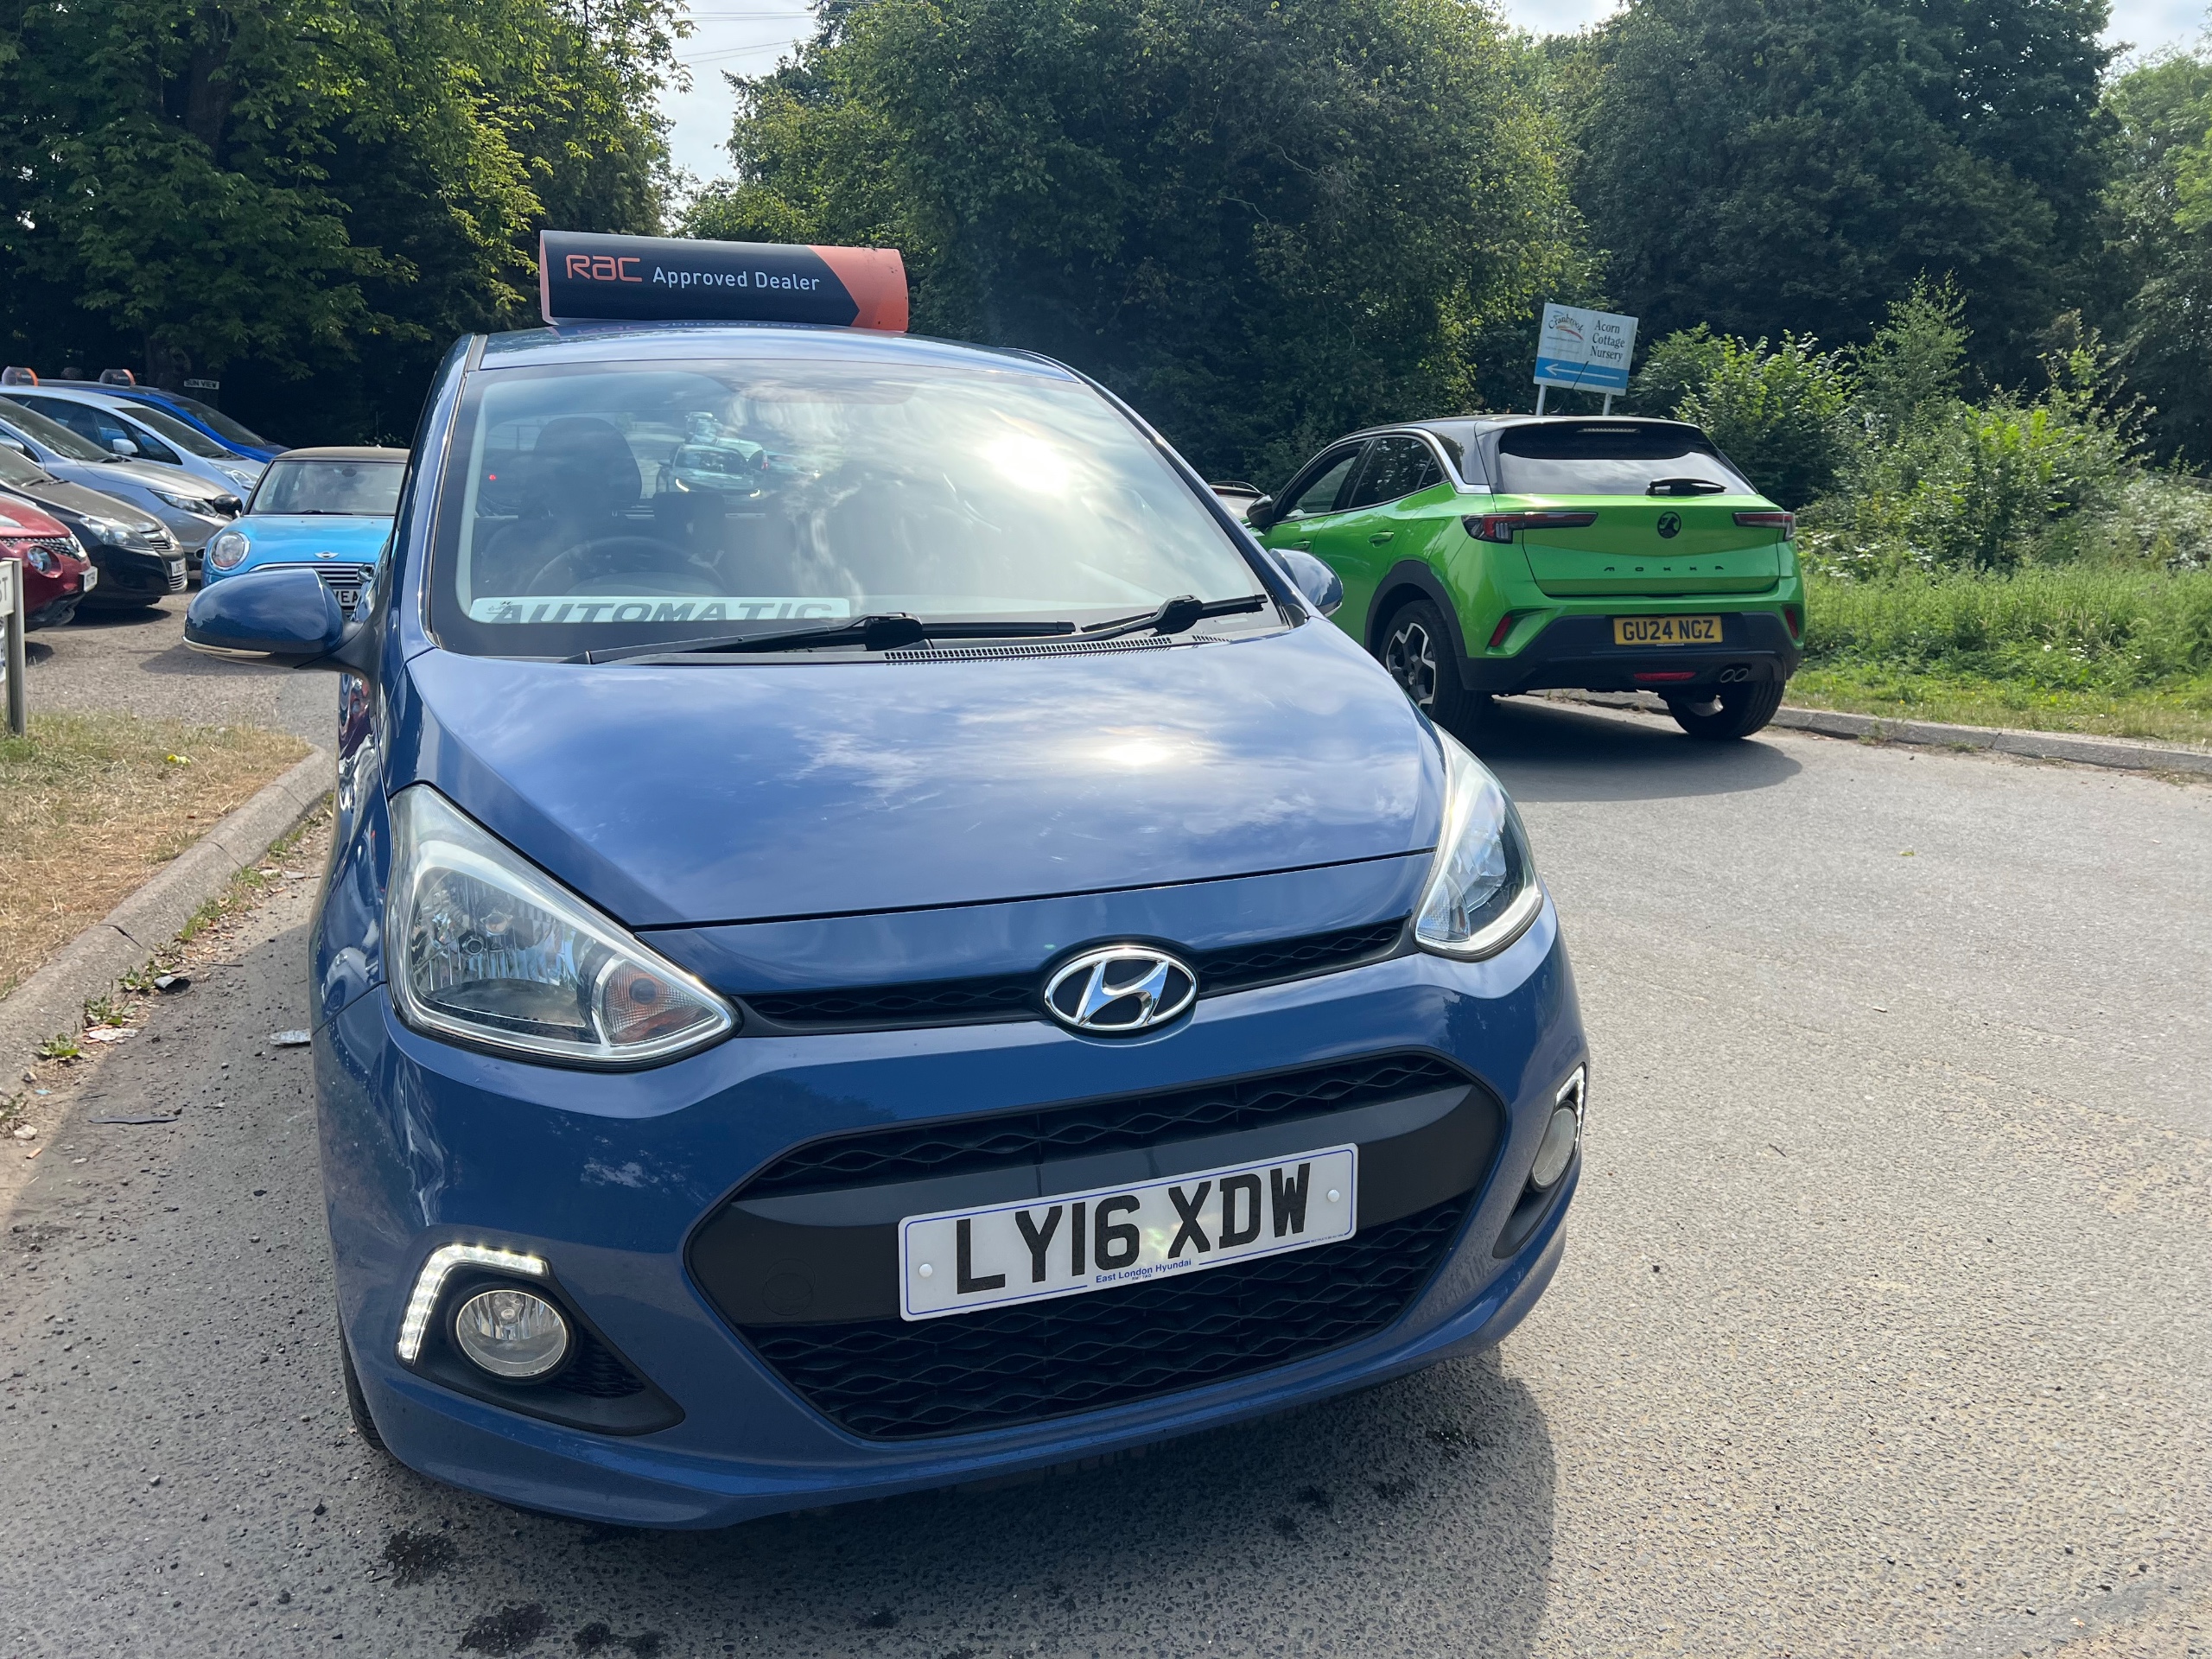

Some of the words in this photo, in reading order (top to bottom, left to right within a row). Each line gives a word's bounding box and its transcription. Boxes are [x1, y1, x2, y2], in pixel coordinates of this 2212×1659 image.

[652, 267, 747, 289] Approved
[756, 272, 820, 291] Dealer
[1548, 314, 1584, 333] Cranbrook
[1594, 320, 1620, 334] Acorn
[1592, 333, 1624, 349] Cottage
[1590, 346, 1623, 362] Nursery
[490, 602, 834, 623] AUTOMATIC
[1623, 620, 1673, 641] GU24
[1678, 620, 1714, 639] NGZ
[957, 1194, 1141, 1294] LY16
[1167, 1163, 1311, 1259] XDW
[1096, 1274, 1116, 1283] East
[1118, 1267, 1153, 1279] London
[1155, 1258, 1192, 1272] Hyundai
